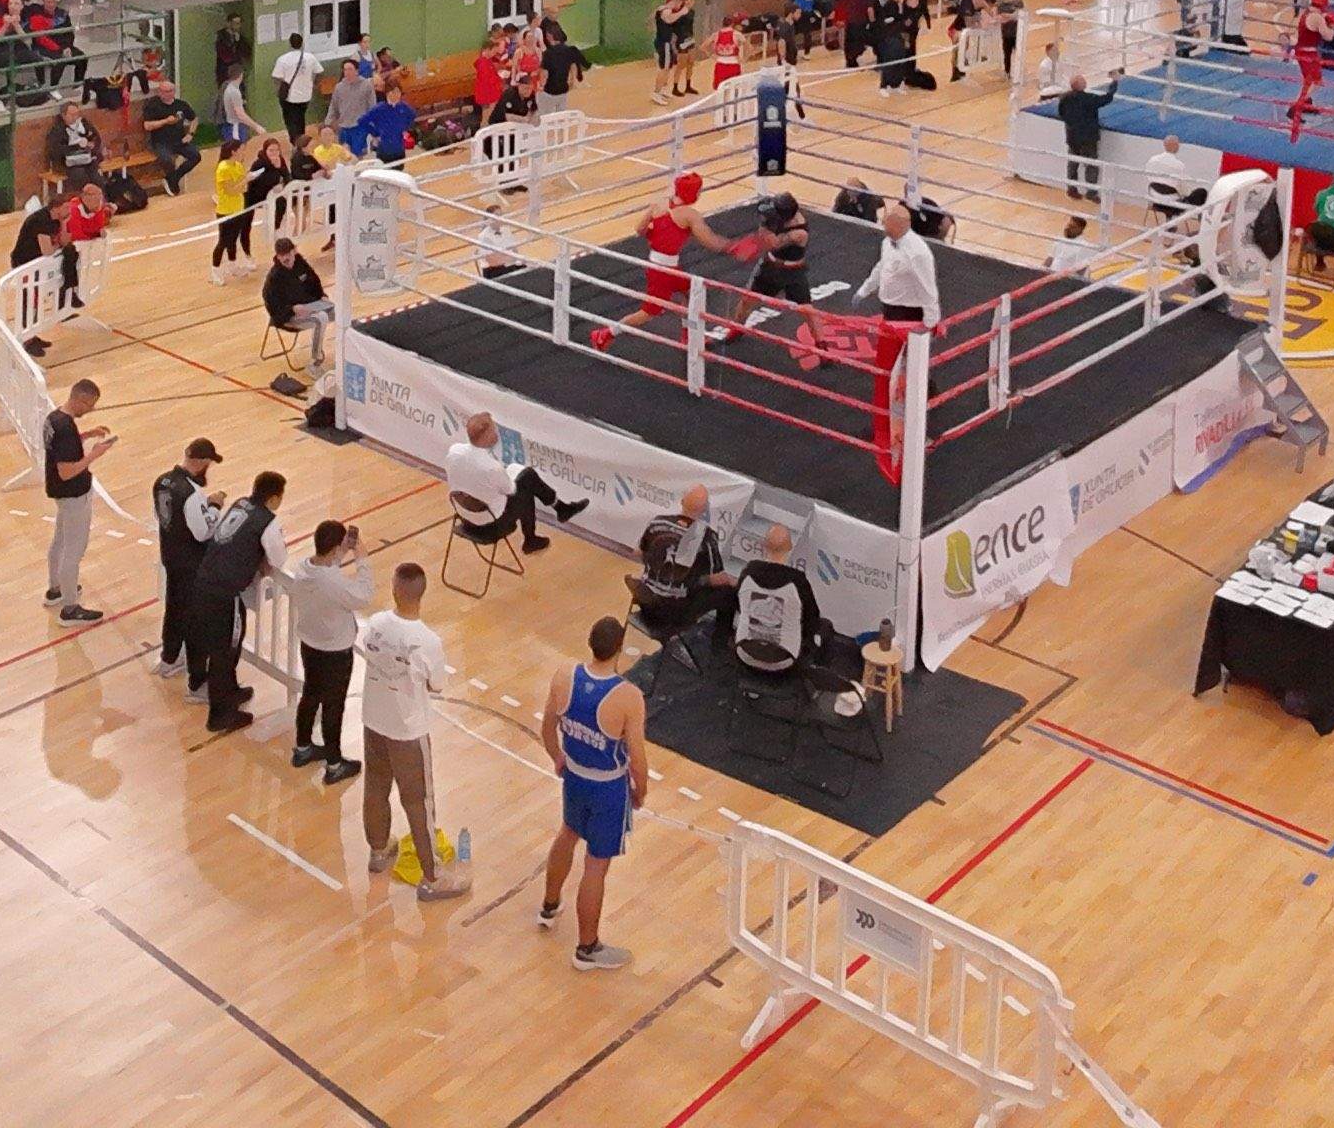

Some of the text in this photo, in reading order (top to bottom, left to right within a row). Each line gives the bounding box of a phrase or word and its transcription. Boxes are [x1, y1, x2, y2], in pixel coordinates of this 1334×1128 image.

[369, 389, 385, 407] DE
[388, 398, 436, 429] GALICIA
[371, 376, 411, 402] XUNTA
[526, 438, 575, 466] XUNTA
[531, 456, 607, 497] DE GALICIA
[974, 504, 1046, 576] ence
